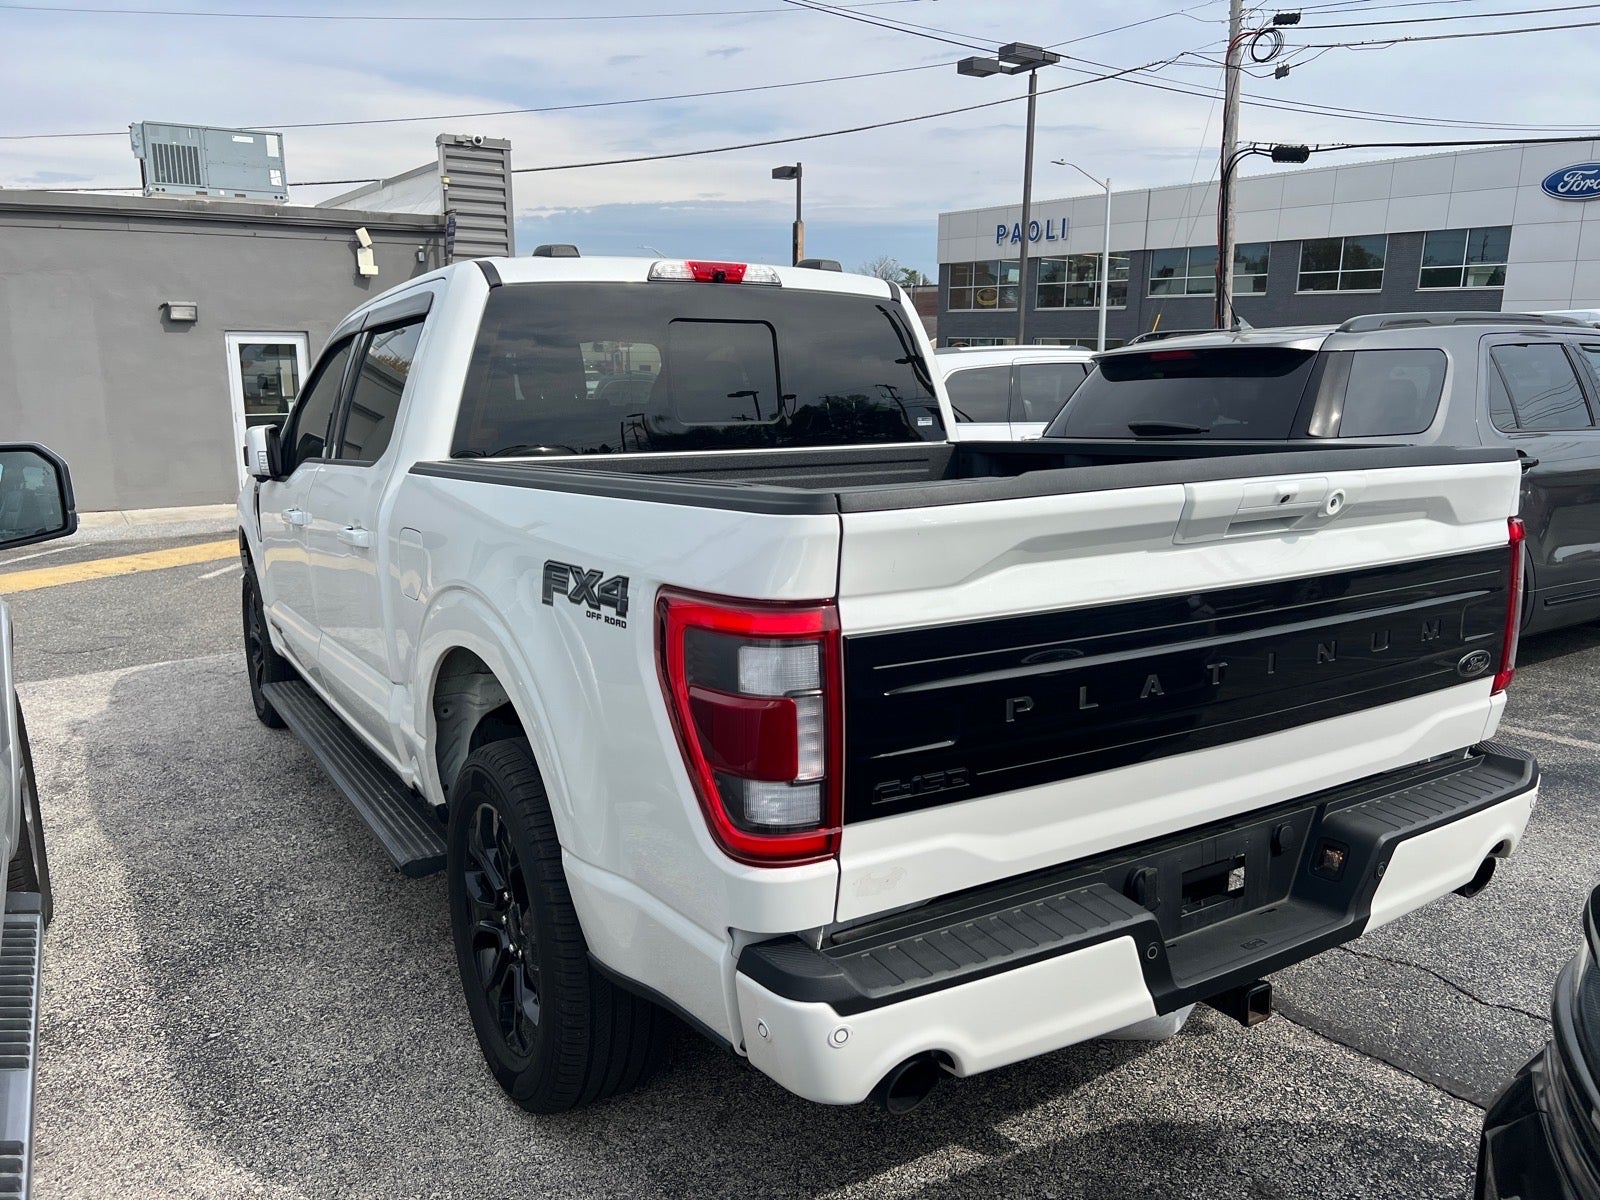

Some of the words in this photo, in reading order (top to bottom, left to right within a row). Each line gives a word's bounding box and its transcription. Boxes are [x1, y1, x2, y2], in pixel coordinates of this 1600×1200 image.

[996, 217, 1067, 245] PAOLI
[542, 559, 630, 619] FX4
[586, 610, 602, 621] OFF
[604, 615, 627, 629] ROAD
[1005, 619, 1442, 723] PLATINUM
